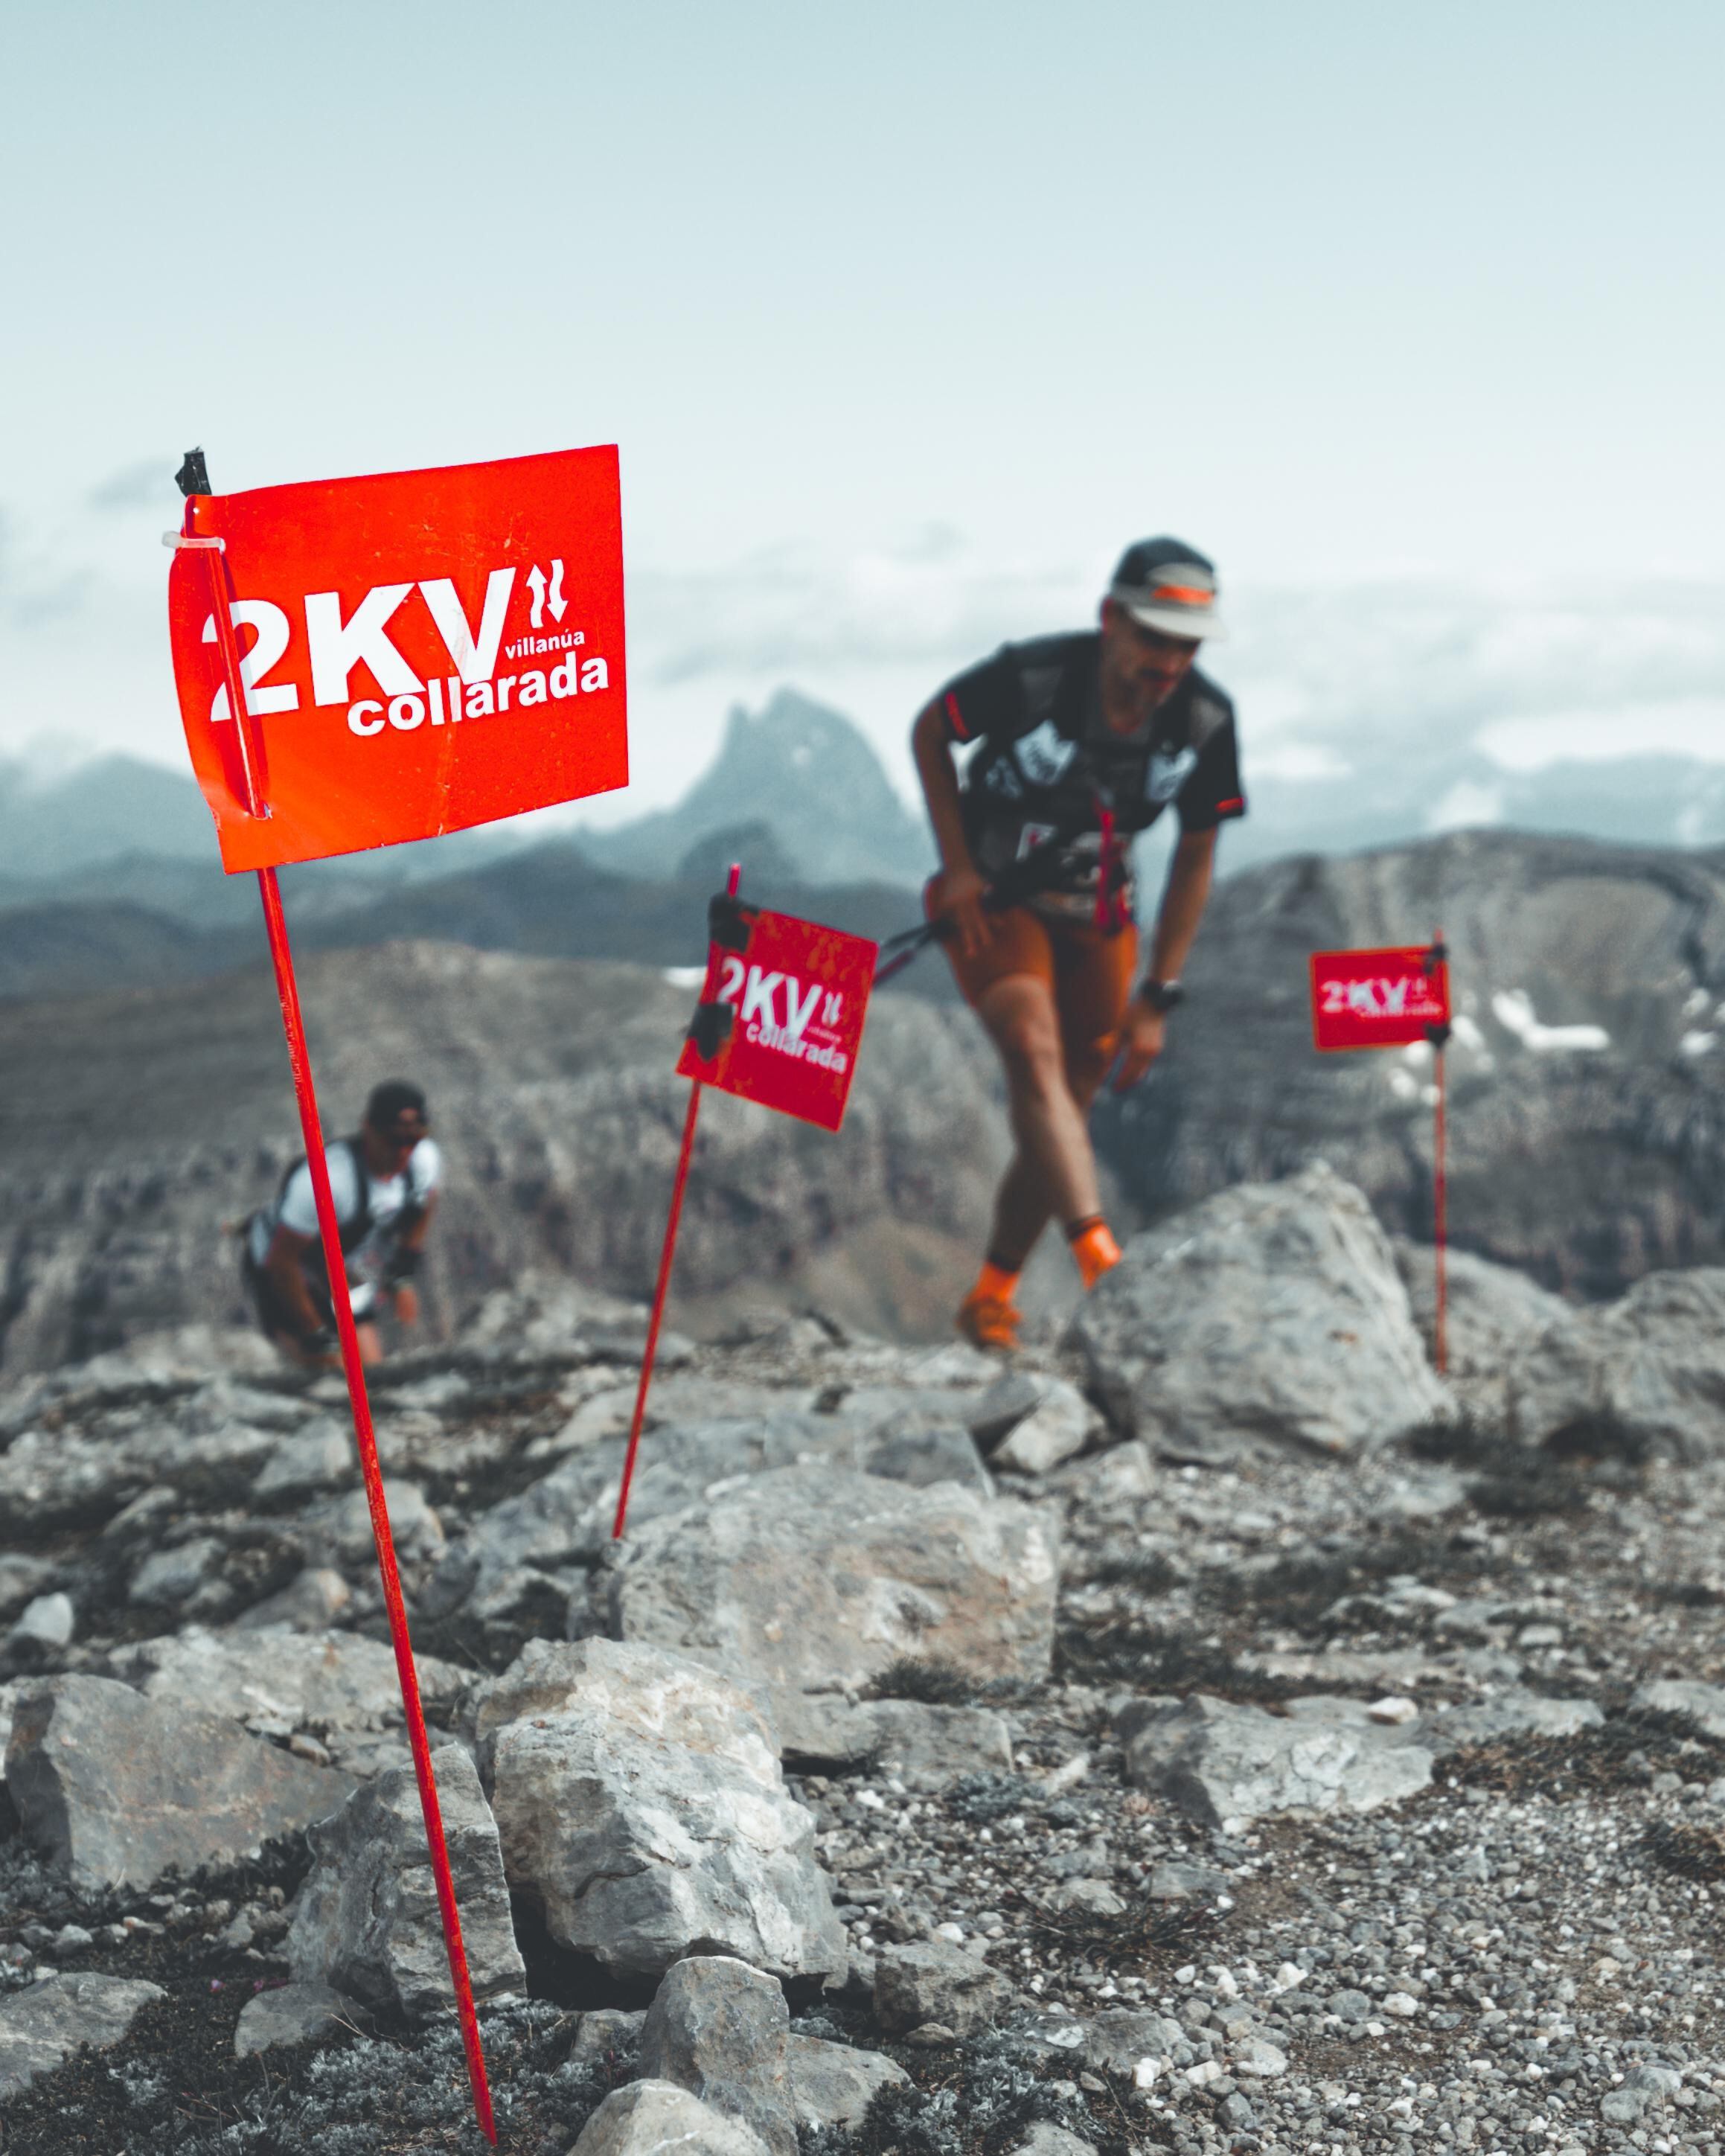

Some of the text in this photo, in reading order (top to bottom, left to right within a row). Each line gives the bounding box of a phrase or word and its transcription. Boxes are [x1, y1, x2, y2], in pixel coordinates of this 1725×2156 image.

[202, 567, 515, 721] 2KV
[505, 629, 585, 659] villanúa
[348, 652, 609, 735] collarada
[718, 956, 822, 1037] 2KV
